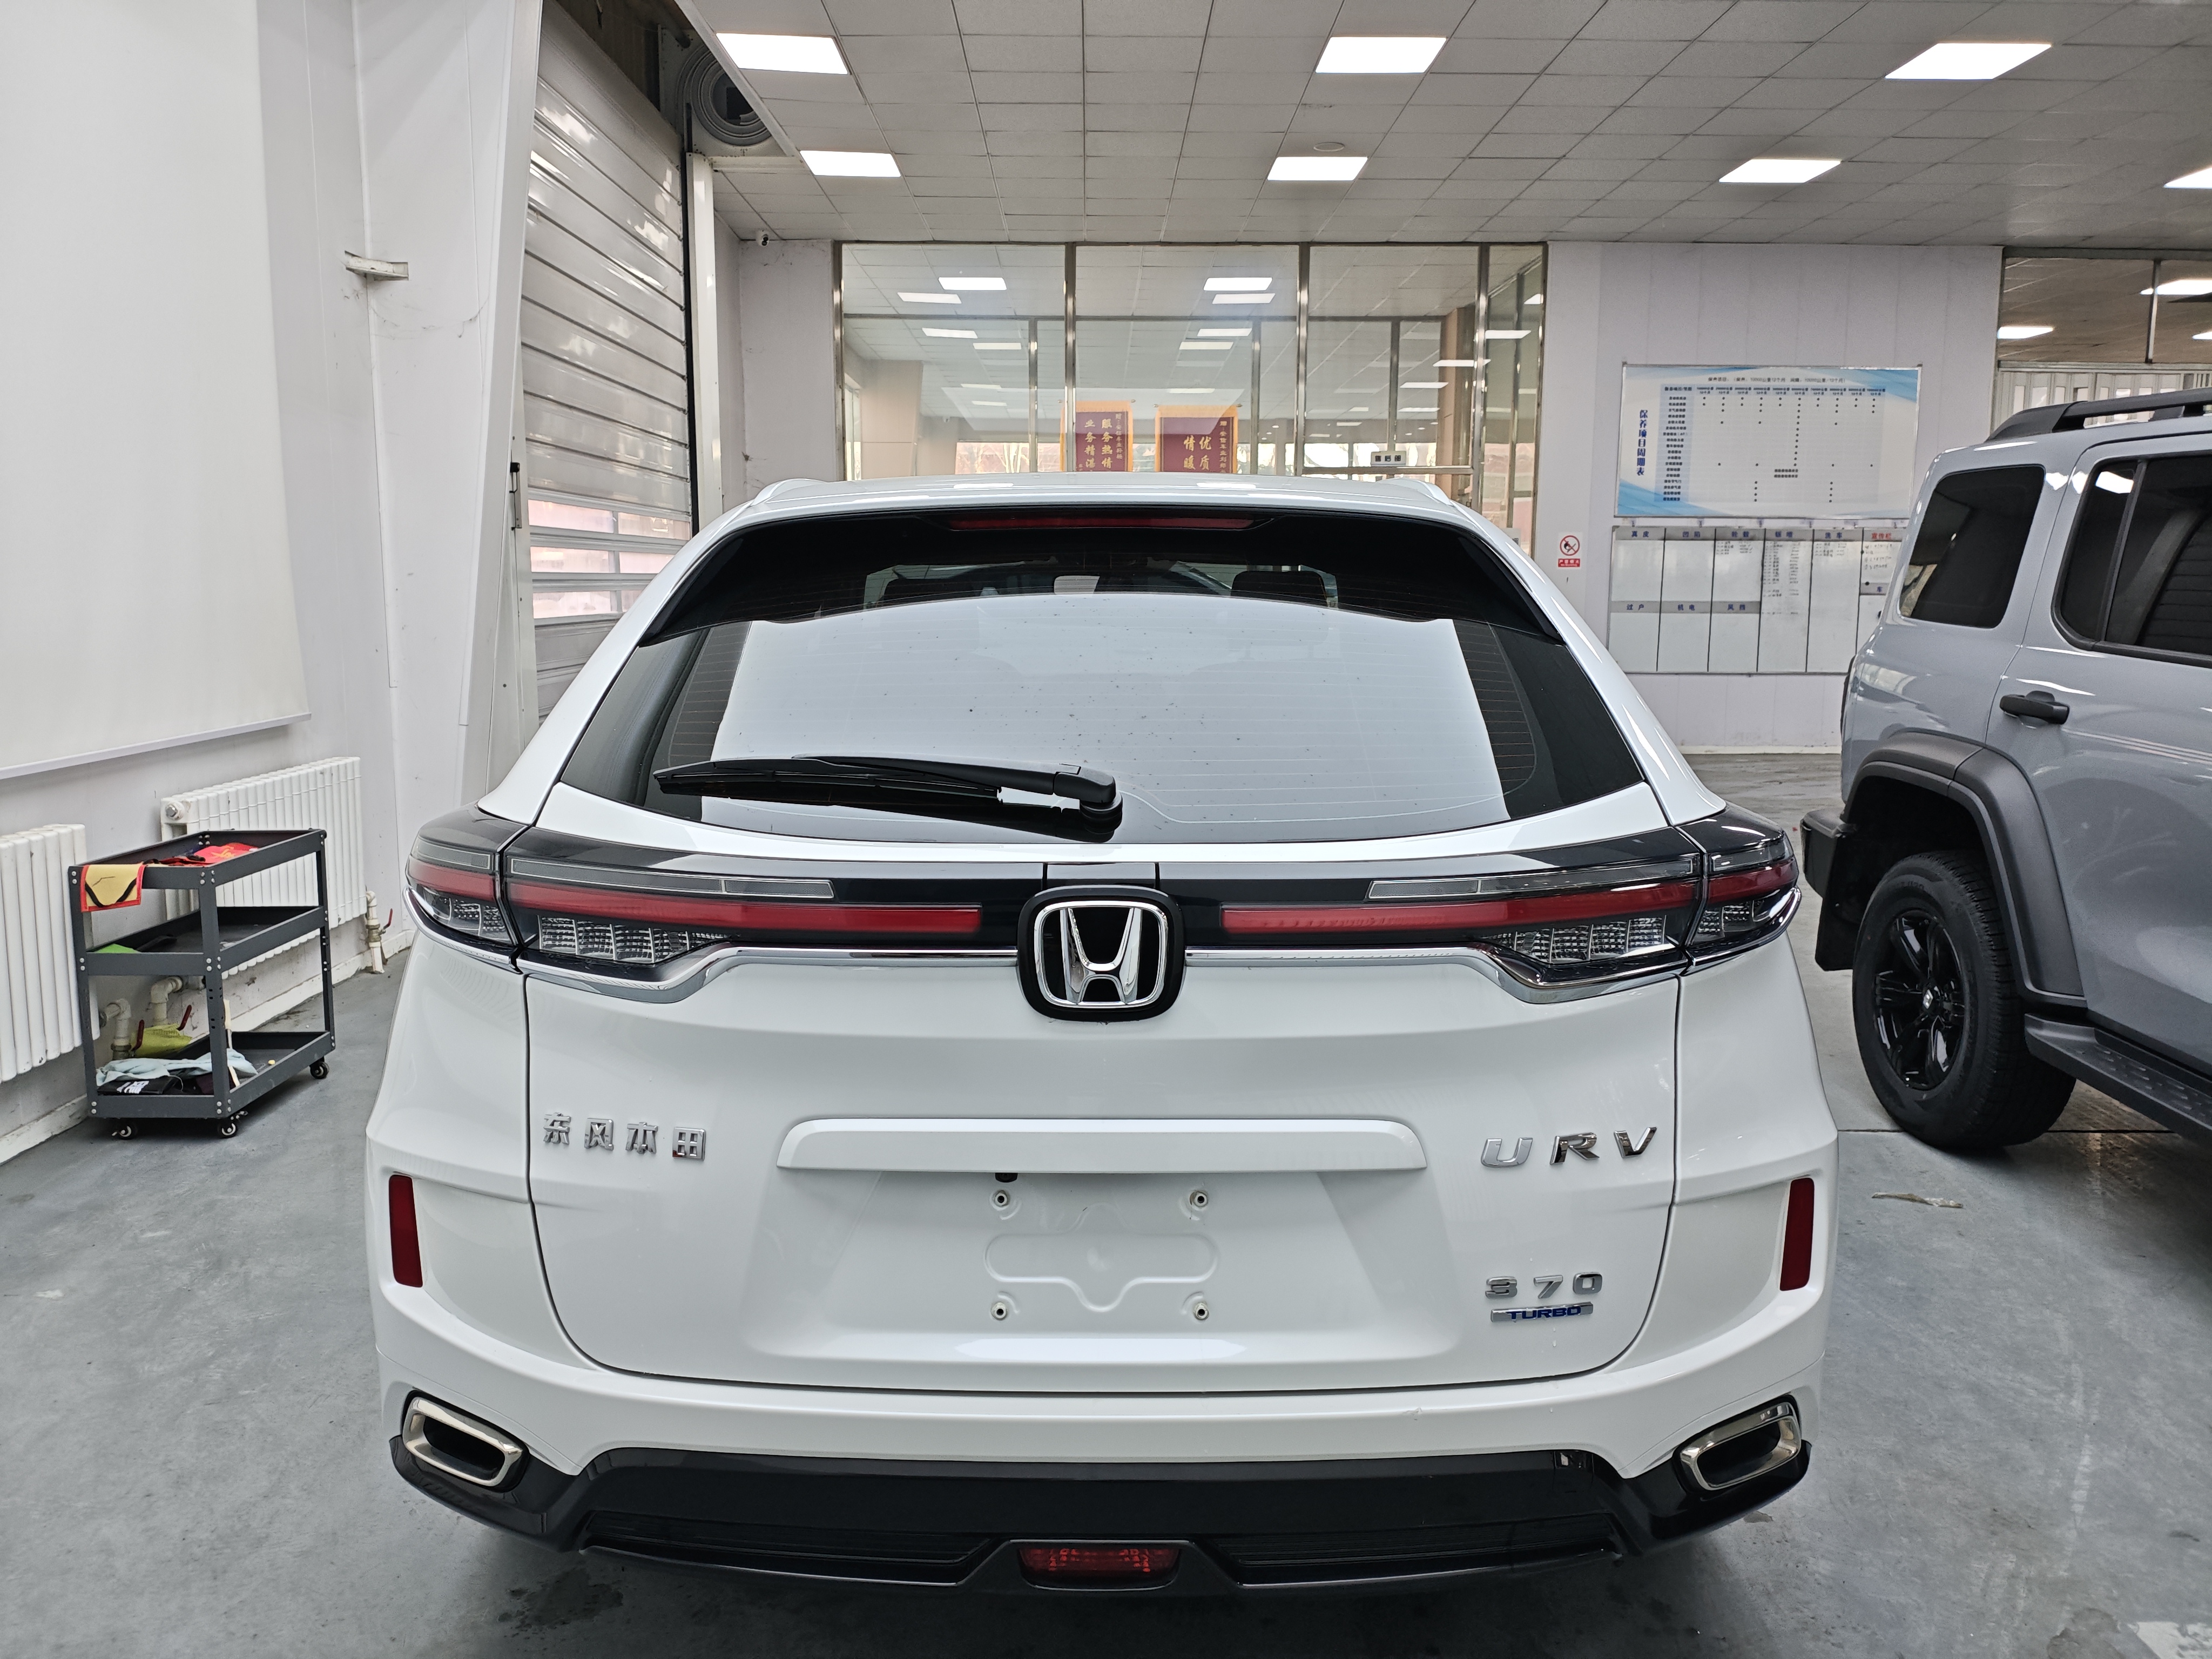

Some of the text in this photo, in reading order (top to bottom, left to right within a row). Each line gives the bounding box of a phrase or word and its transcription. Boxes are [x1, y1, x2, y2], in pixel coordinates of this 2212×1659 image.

[1084, 419, 1096, 471] 业务精湛
[1102, 419, 1113, 469] 服务热情
[1184, 435, 1196, 470] 情暖
[1199, 436, 1212, 470] 优质
[543, 1112, 706, 1161] 东风本田
[1480, 1126, 1658, 1168] URV
[1485, 1271, 1603, 1299] 370
[1505, 1306, 1581, 1320] TURBO
